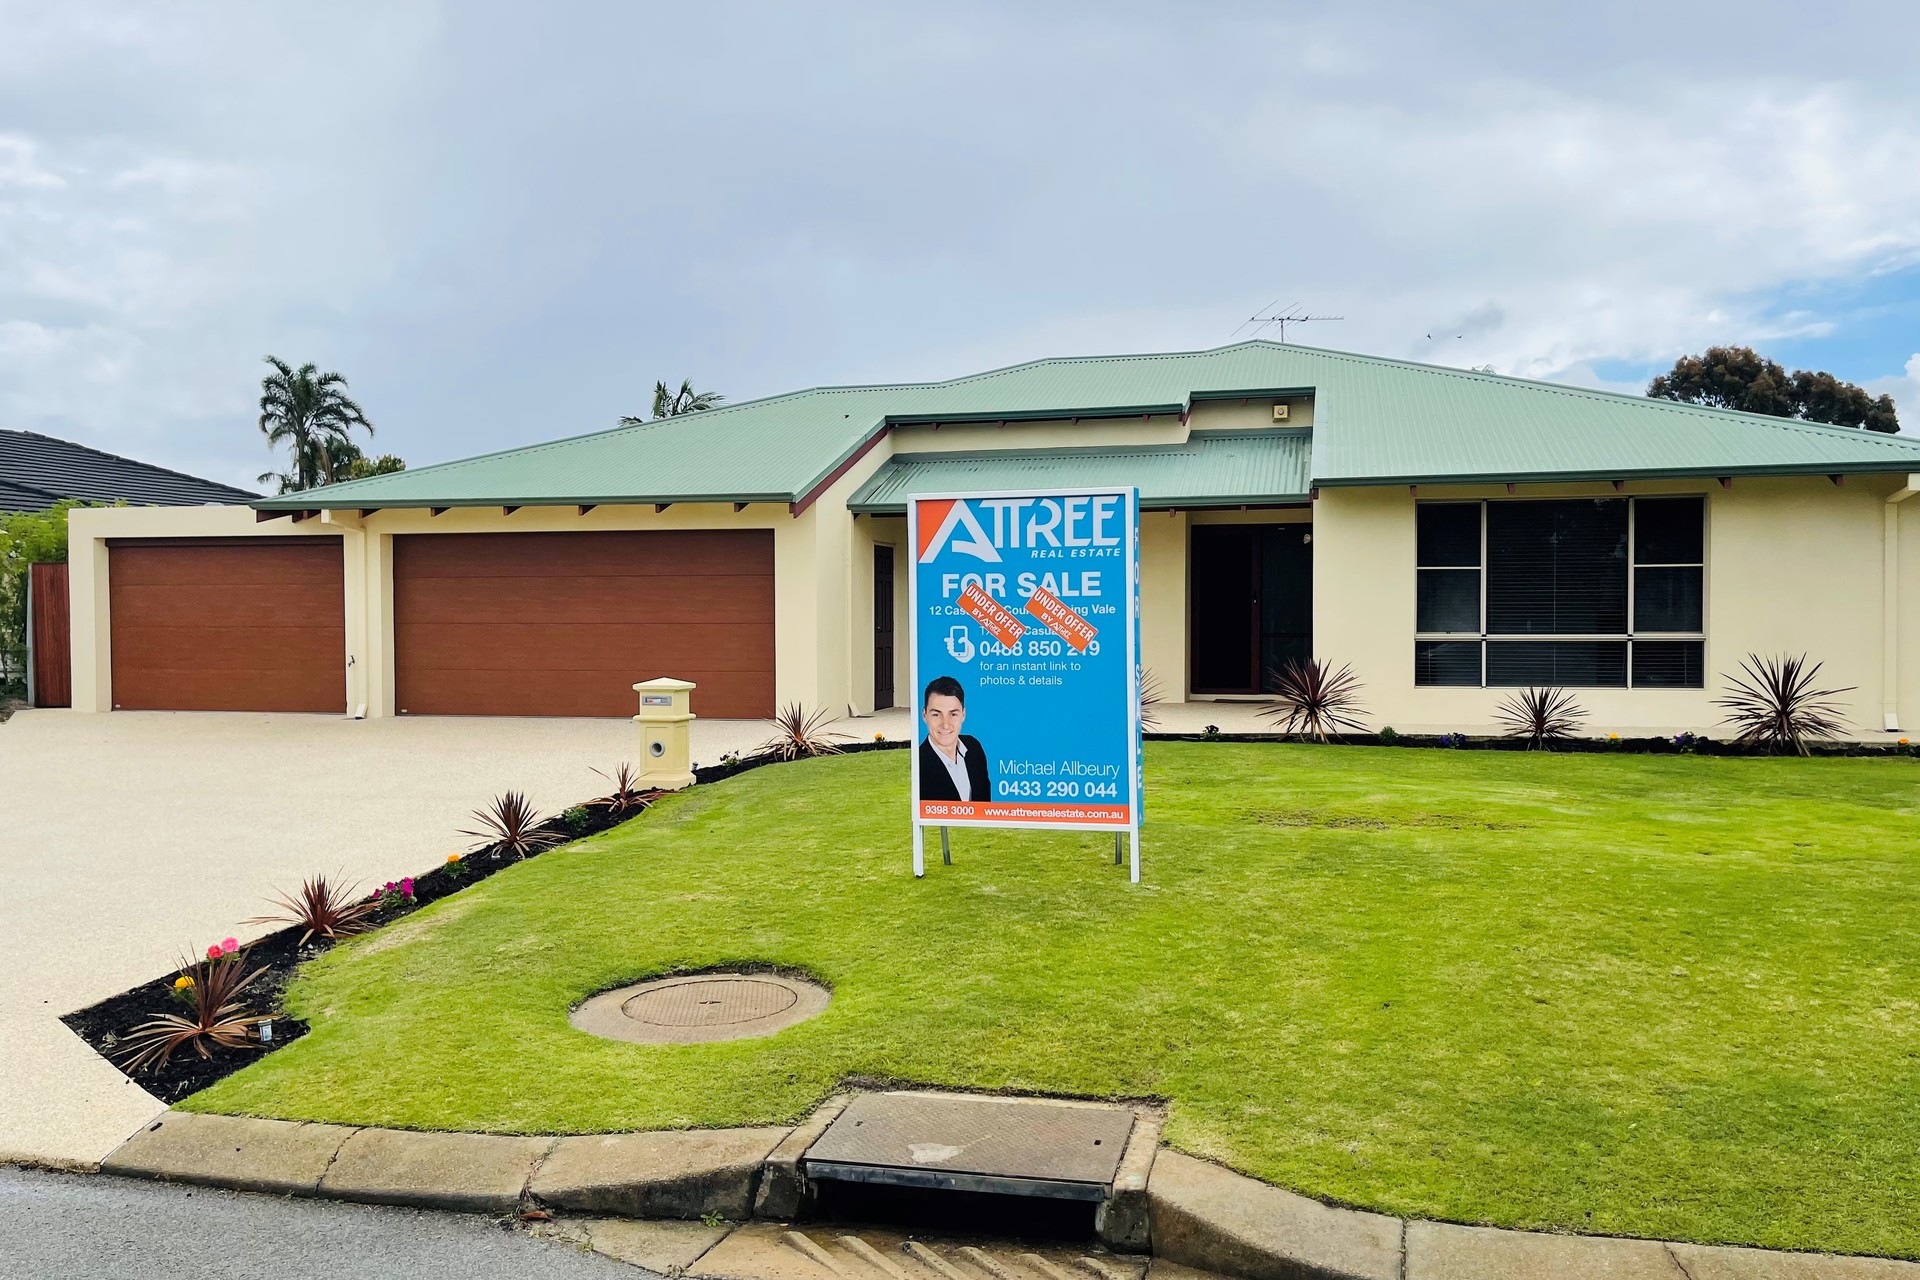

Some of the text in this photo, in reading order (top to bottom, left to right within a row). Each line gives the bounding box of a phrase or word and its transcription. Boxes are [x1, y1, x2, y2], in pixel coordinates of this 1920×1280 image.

[918, 496, 1121, 564] ATTREE
[1031, 548, 1121, 559] REAL ESTATE
[942, 571, 1102, 598] FOR SALE
[929, 605, 942, 616] 12
[1003, 604, 1029, 615] Cour
[1091, 603, 1117, 614] Vale
[965, 585, 1024, 639] UNDER OFFER
[971, 607, 985, 620] BY
[1033, 589, 1067, 620] UNDER
[1064, 614, 1095, 642] OFFER
[1040, 611, 1054, 624] BY
[979, 640, 1023, 657] 0488
[1028, 640, 1062, 657] 850
[980, 660, 1082, 671] for an instant link to
[980, 675, 1063, 687] photos & details
[999, 759, 1120, 780] Michael Allbeury
[998, 780, 1118, 799] 0433 290 044
[925, 805, 1124, 820] 9398 3000 www.attreerealestate.com.au
